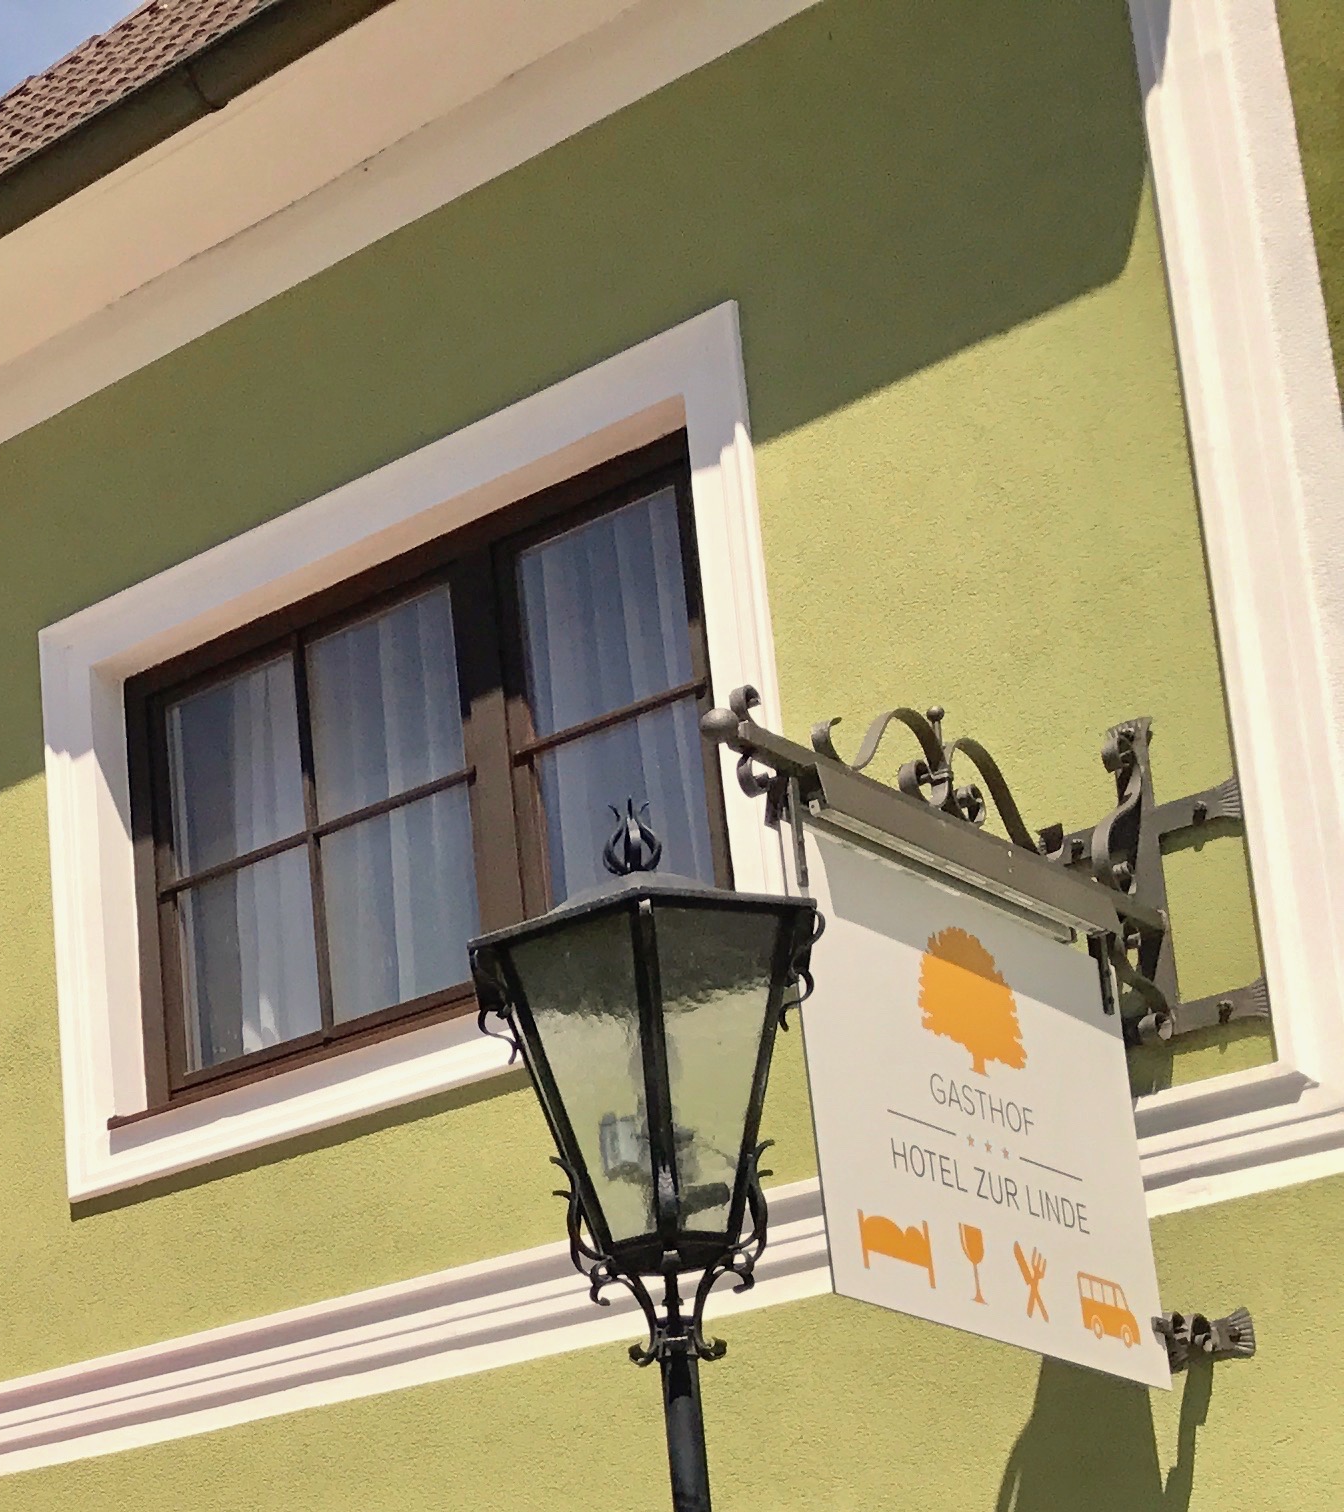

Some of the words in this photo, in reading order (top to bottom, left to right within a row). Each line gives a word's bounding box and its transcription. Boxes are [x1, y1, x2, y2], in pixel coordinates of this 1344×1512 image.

[928, 1072, 1036, 1137] GASTHOF
[890, 1136, 969, 1194] HOTEL
[972, 1165, 1021, 1213] ZUR
[1025, 1184, 1091, 1235] LINDE
